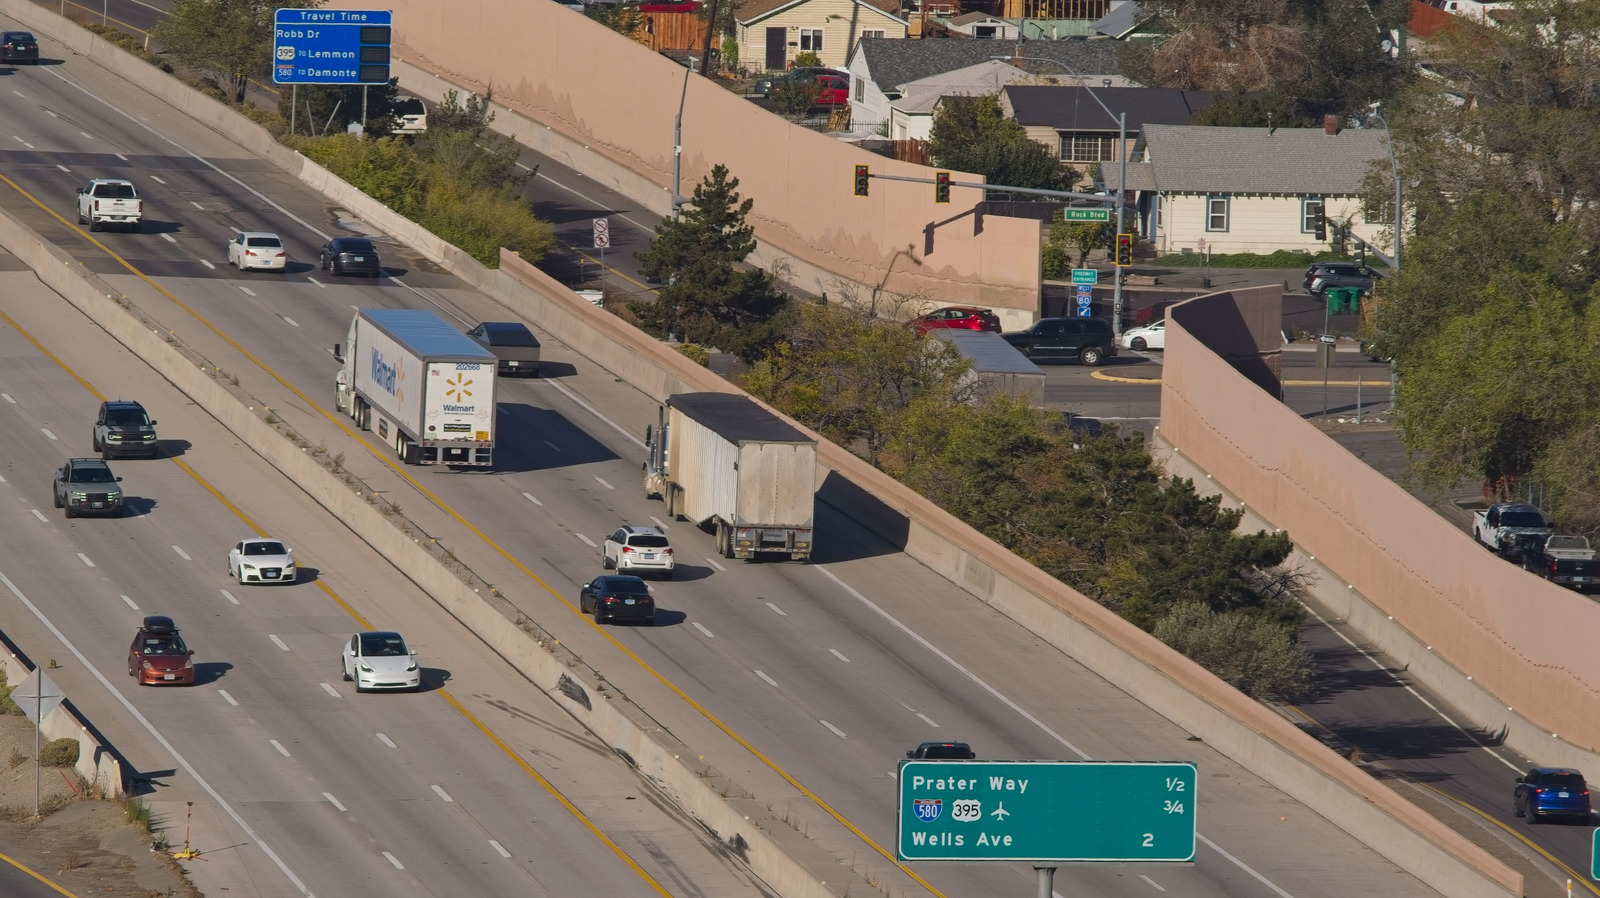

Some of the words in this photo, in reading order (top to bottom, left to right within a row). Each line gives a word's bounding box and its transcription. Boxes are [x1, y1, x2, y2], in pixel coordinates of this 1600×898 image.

[300, 11, 335, 21] Travel
[340, 12, 367, 21] Time
[276, 29, 304, 38] Robb
[307, 30, 320, 38] Dr
[277, 48, 294, 57] 395
[308, 50, 355, 58] Lemmon
[278, 68, 292, 76] 580
[307, 68, 357, 77] Damonte
[371, 346, 396, 397] Walmart
[442, 404, 475, 412] Walmart
[912, 776, 977, 790] Prater
[989, 776, 1029, 794] Way
[918, 804, 938, 818] 580
[953, 803, 980, 817] 395
[912, 832, 965, 846] Wells
[976, 832, 1013, 846] Ave
[1142, 833, 1154, 847] 2
